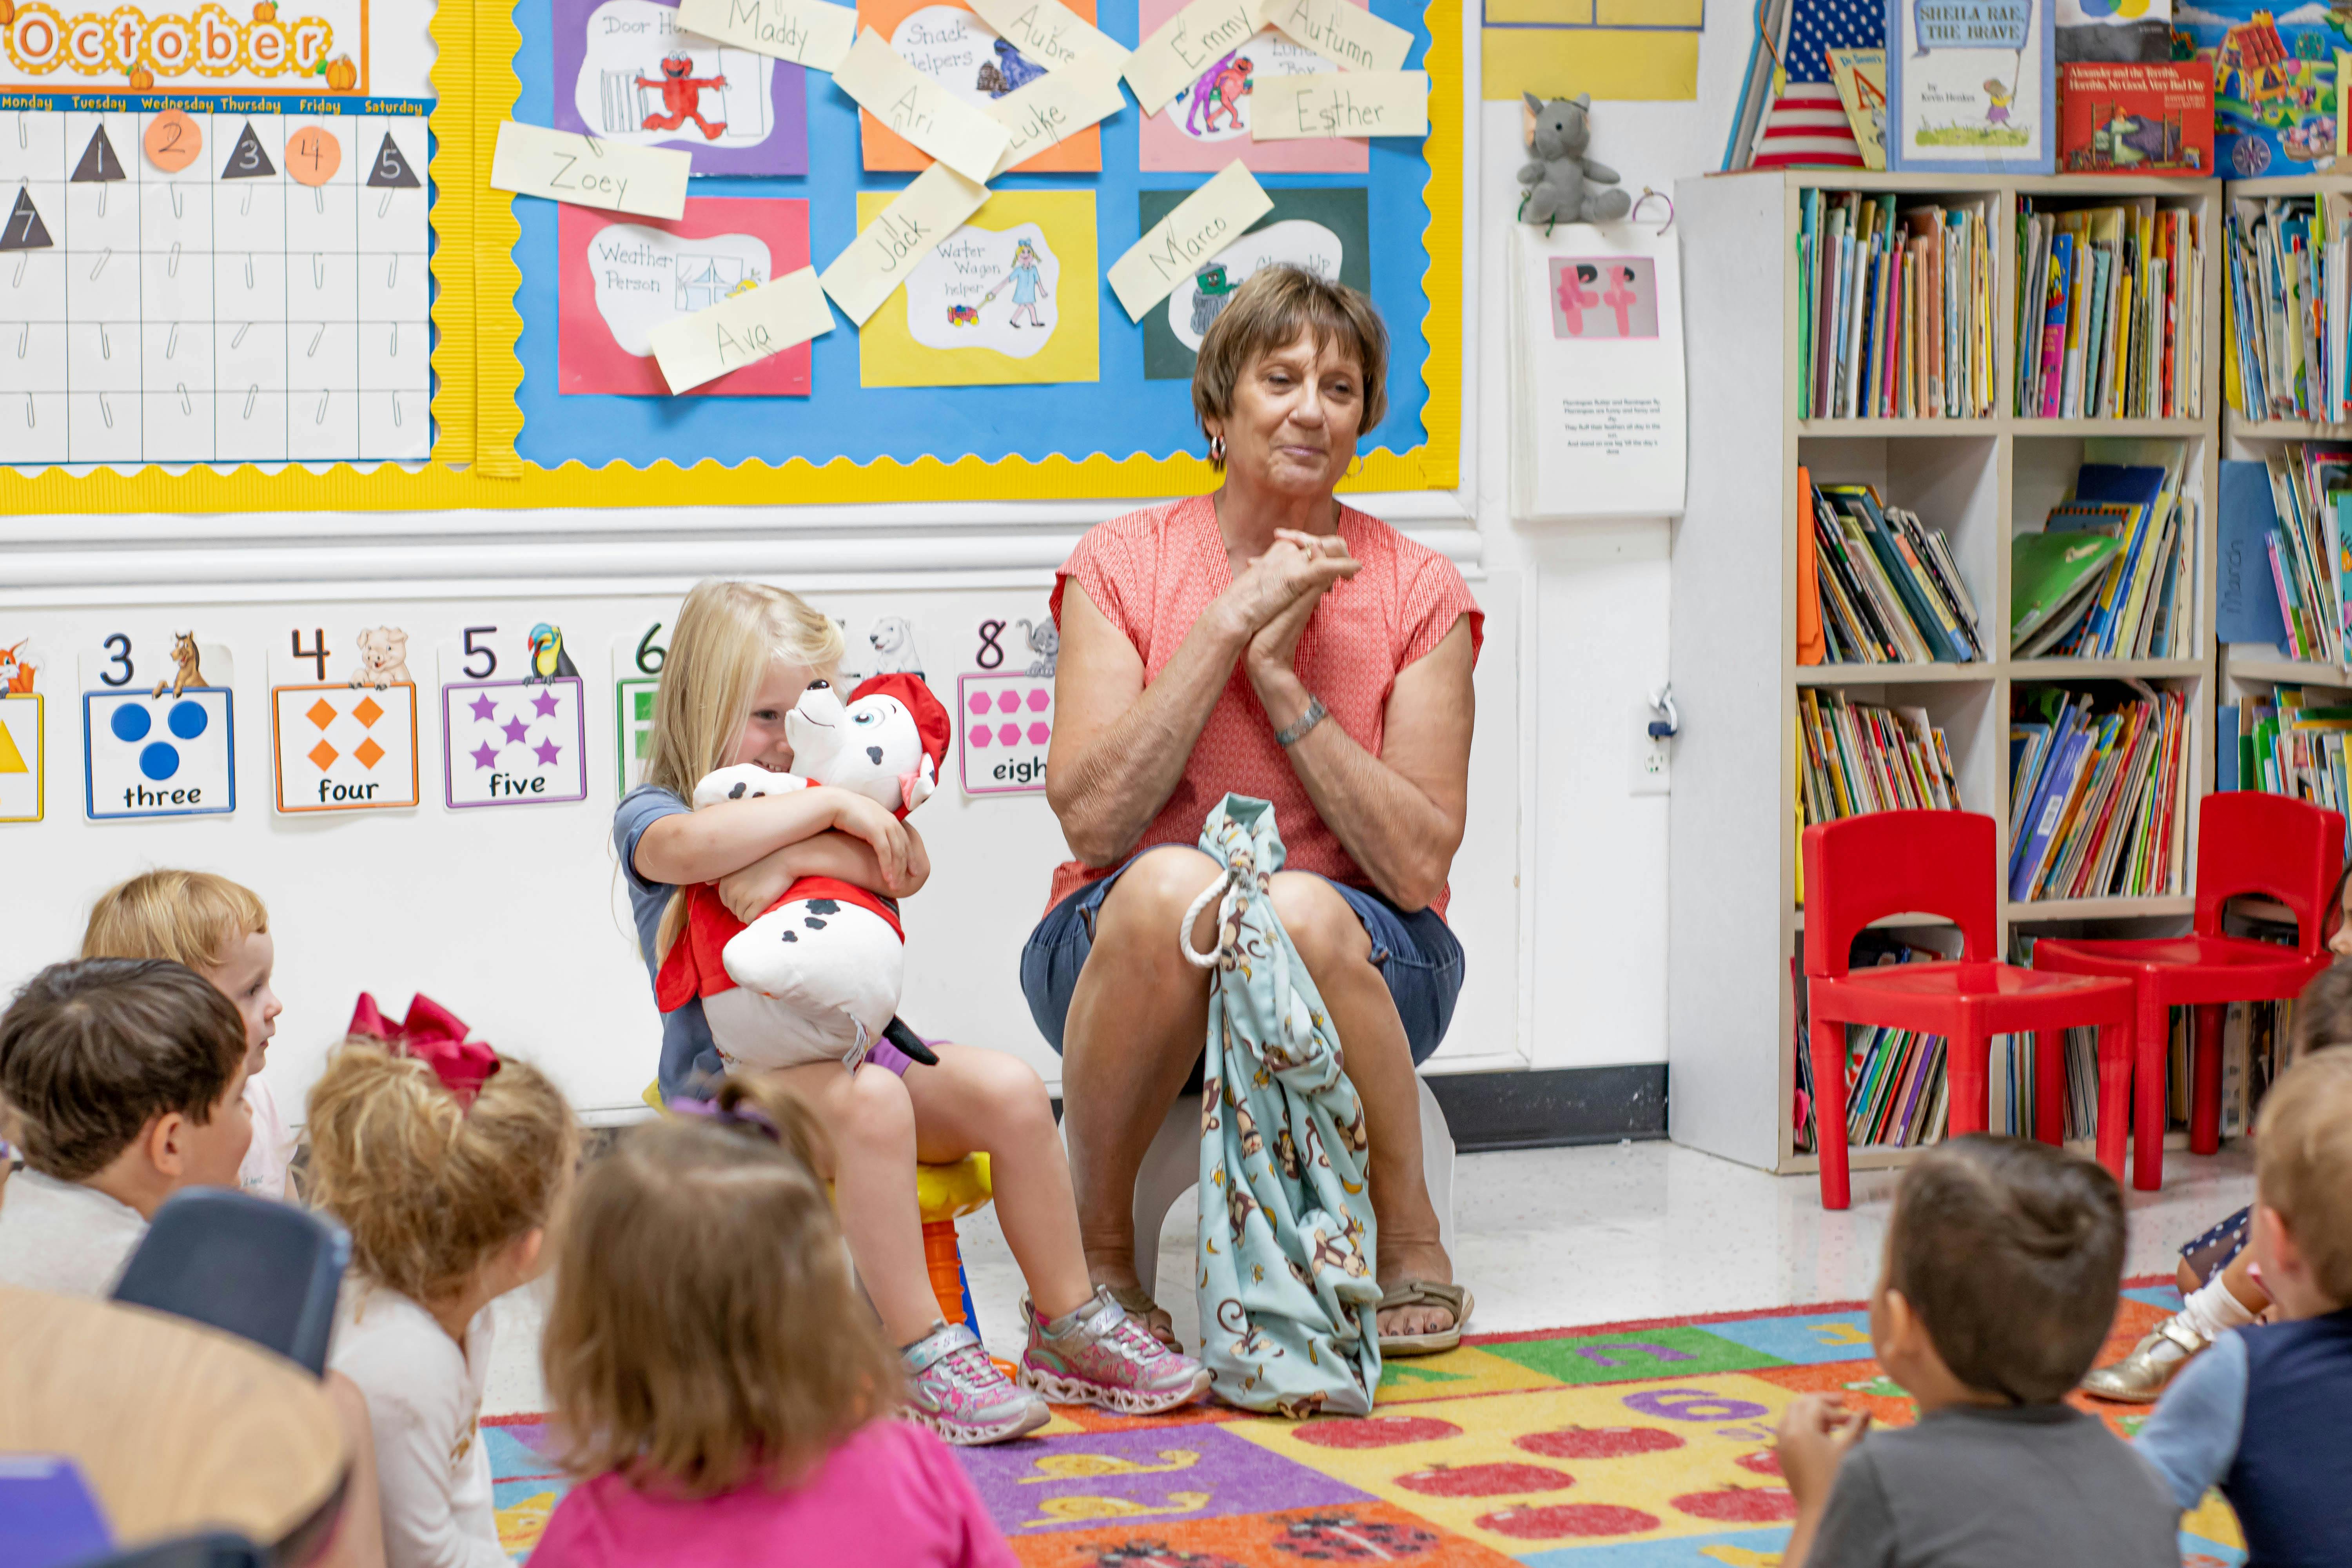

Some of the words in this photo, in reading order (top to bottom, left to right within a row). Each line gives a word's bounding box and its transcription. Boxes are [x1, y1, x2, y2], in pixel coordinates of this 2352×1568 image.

[603, 16, 651, 35] Door
[729, 0, 808, 60] Maddy
[907, 19, 967, 44] Snack
[1920, 6, 1980, 21] SHEILA
[1926, 25, 1960, 40] THE
[1967, 25, 2020, 40] BRAVE
[19, 20, 321, 60] October
[1171, 5, 1255, 69] Emmy
[1289, 0, 1373, 69] Autumn
[2, 94, 53, 111] Monday
[72, 95, 127, 113] Tuesday
[142, 97, 214, 113] Wednesday
[221, 96, 281, 114] Thursday
[300, 99, 341, 115] Friday
[365, 100, 422, 116] Saturday
[891, 84, 935, 134] Ari
[1297, 89, 1384, 132] Esther
[998, 104, 1066, 148] Luke
[158, 122, 185, 153] 2
[239, 139, 260, 169] 3
[301, 138, 323, 171] 4
[380, 149, 401, 179] 5
[550, 151, 628, 210] Zoey
[15, 209, 36, 242] 7
[876, 214, 931, 272] Jack
[598, 242, 673, 270] Weather
[936, 240, 985, 258] Water
[1149, 216, 1227, 281] Marco
[605, 270, 661, 294] Person
[944, 282, 984, 296] helper
[953, 261, 1001, 278] Wagon
[717, 321, 772, 365] Ava
[100, 633, 134, 687] 3
[291, 628, 331, 681] 4
[463, 626, 497, 679] 5
[635, 622, 667, 674] 6
[976, 619, 1006, 670] 8
[489, 773, 546, 799] five
[993, 756, 1047, 783] eigh
[123, 784, 201, 808] three
[318, 778, 379, 803] four
[1622, 1388, 1769, 1422] 6
